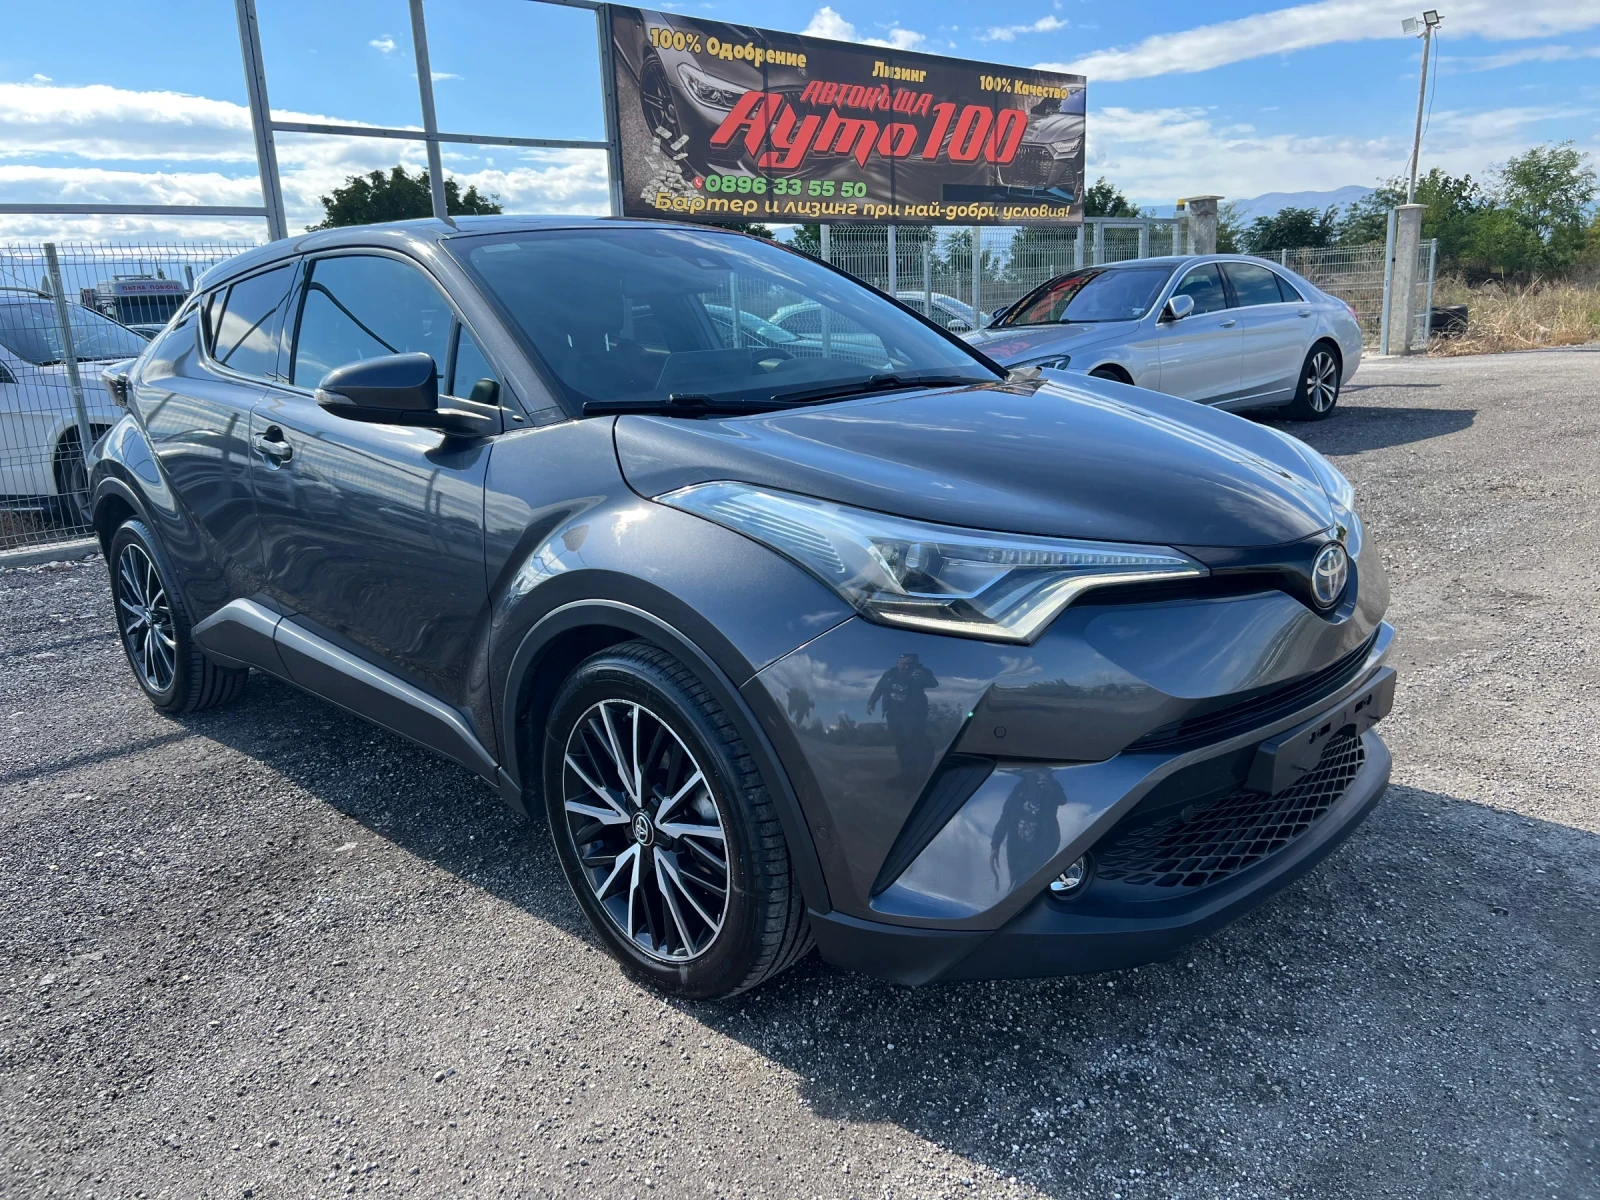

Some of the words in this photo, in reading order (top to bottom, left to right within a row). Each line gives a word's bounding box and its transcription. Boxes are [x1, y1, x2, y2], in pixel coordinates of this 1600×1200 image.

[650, 28, 702, 53] 100%
[706, 37, 807, 68] Одобрение
[872, 61, 927, 83] Лизинг
[979, 75, 1012, 94] 100%
[1014, 79, 1069, 100] Качество
[705, 174, 768, 195] 0896
[773, 177, 802, 196] 33
[807, 179, 836, 197] 55
[840, 181, 868, 198] 50
[655, 191, 758, 216] Бартер
[764, 200, 780, 214] и
[783, 201, 858, 217] лизинг
[863, 202, 900, 219] при
[904, 201, 1000, 220] най-добри
[1002, 204, 1070, 219] условия!
